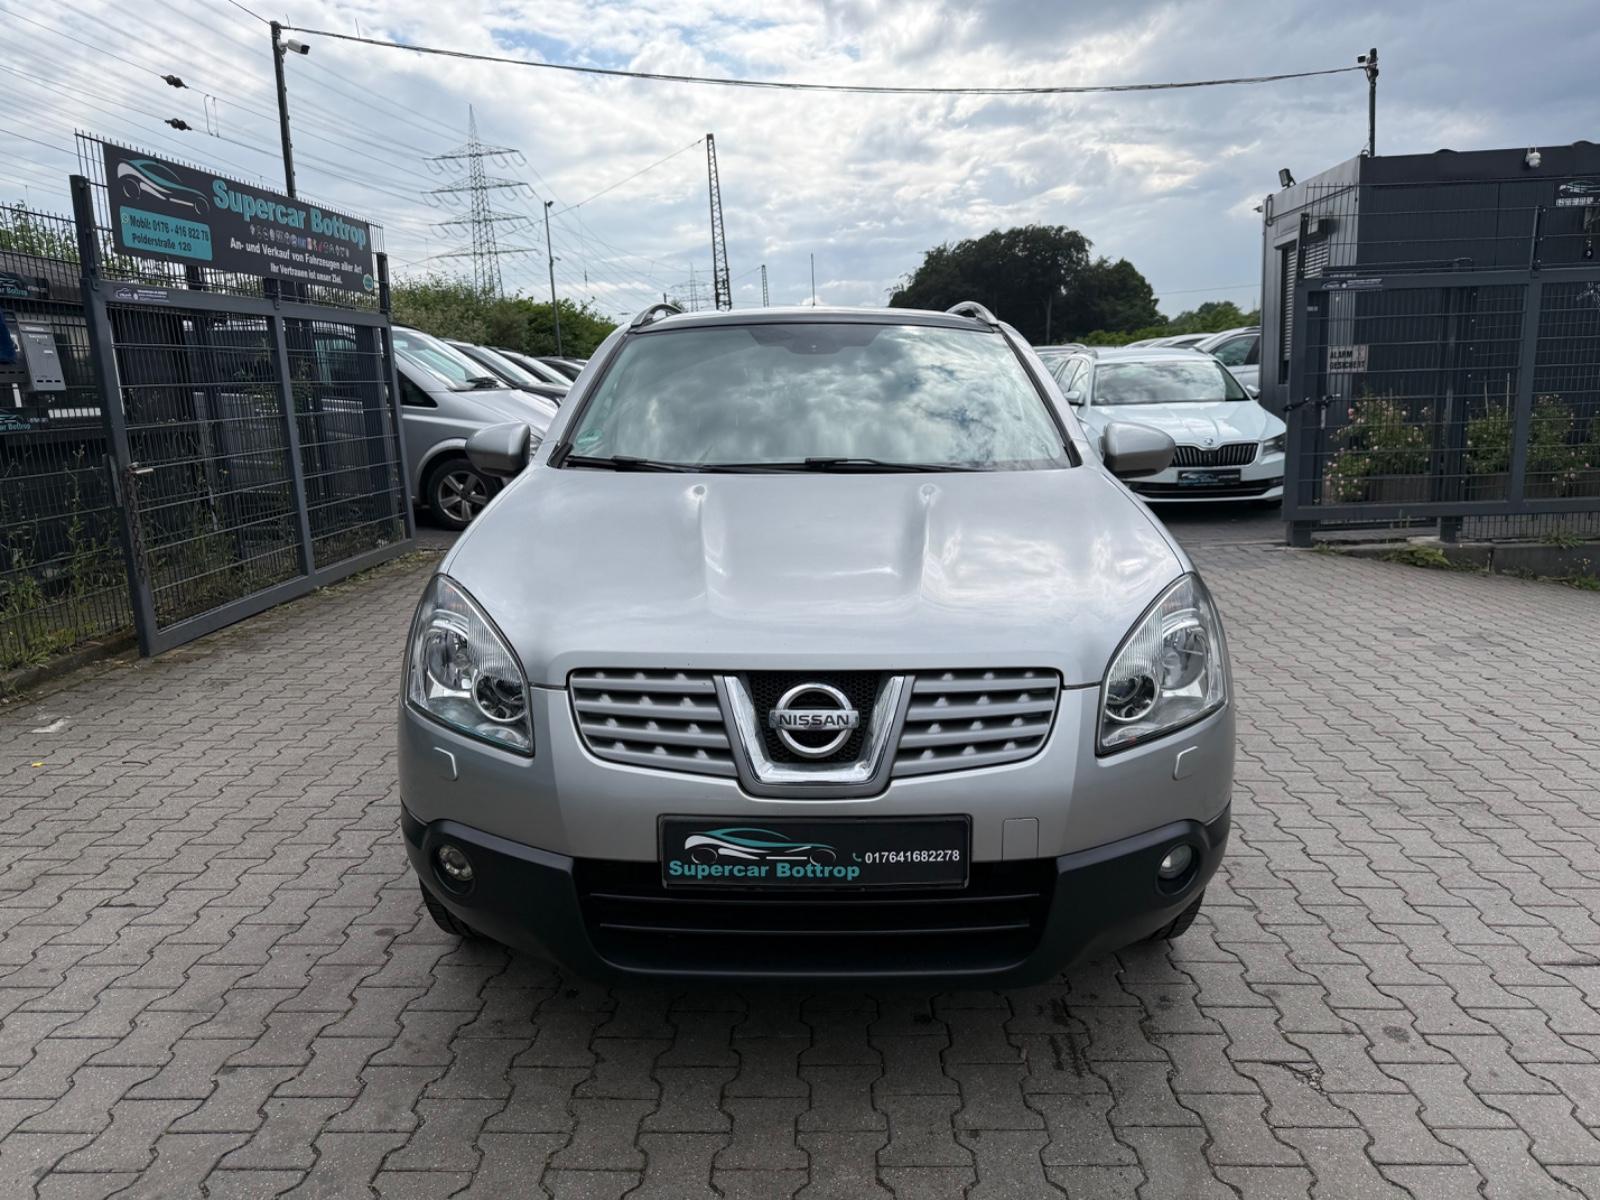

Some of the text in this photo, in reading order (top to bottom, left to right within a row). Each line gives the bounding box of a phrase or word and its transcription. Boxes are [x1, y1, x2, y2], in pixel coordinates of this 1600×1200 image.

[212, 179, 367, 250] Supercar Bottrop
[131, 233, 176, 250] Polderstraße
[230, 237, 244, 250] An-
[245, 242, 260, 254] und
[261, 243, 290, 260] Verkauf
[291, 252, 304, 262] von
[305, 252, 341, 271] Fahrzeugen
[778, 713, 850, 727] NISSAN
[864, 849, 961, 865] 017641682278
[668, 859, 861, 881] Supercar Bottrop
